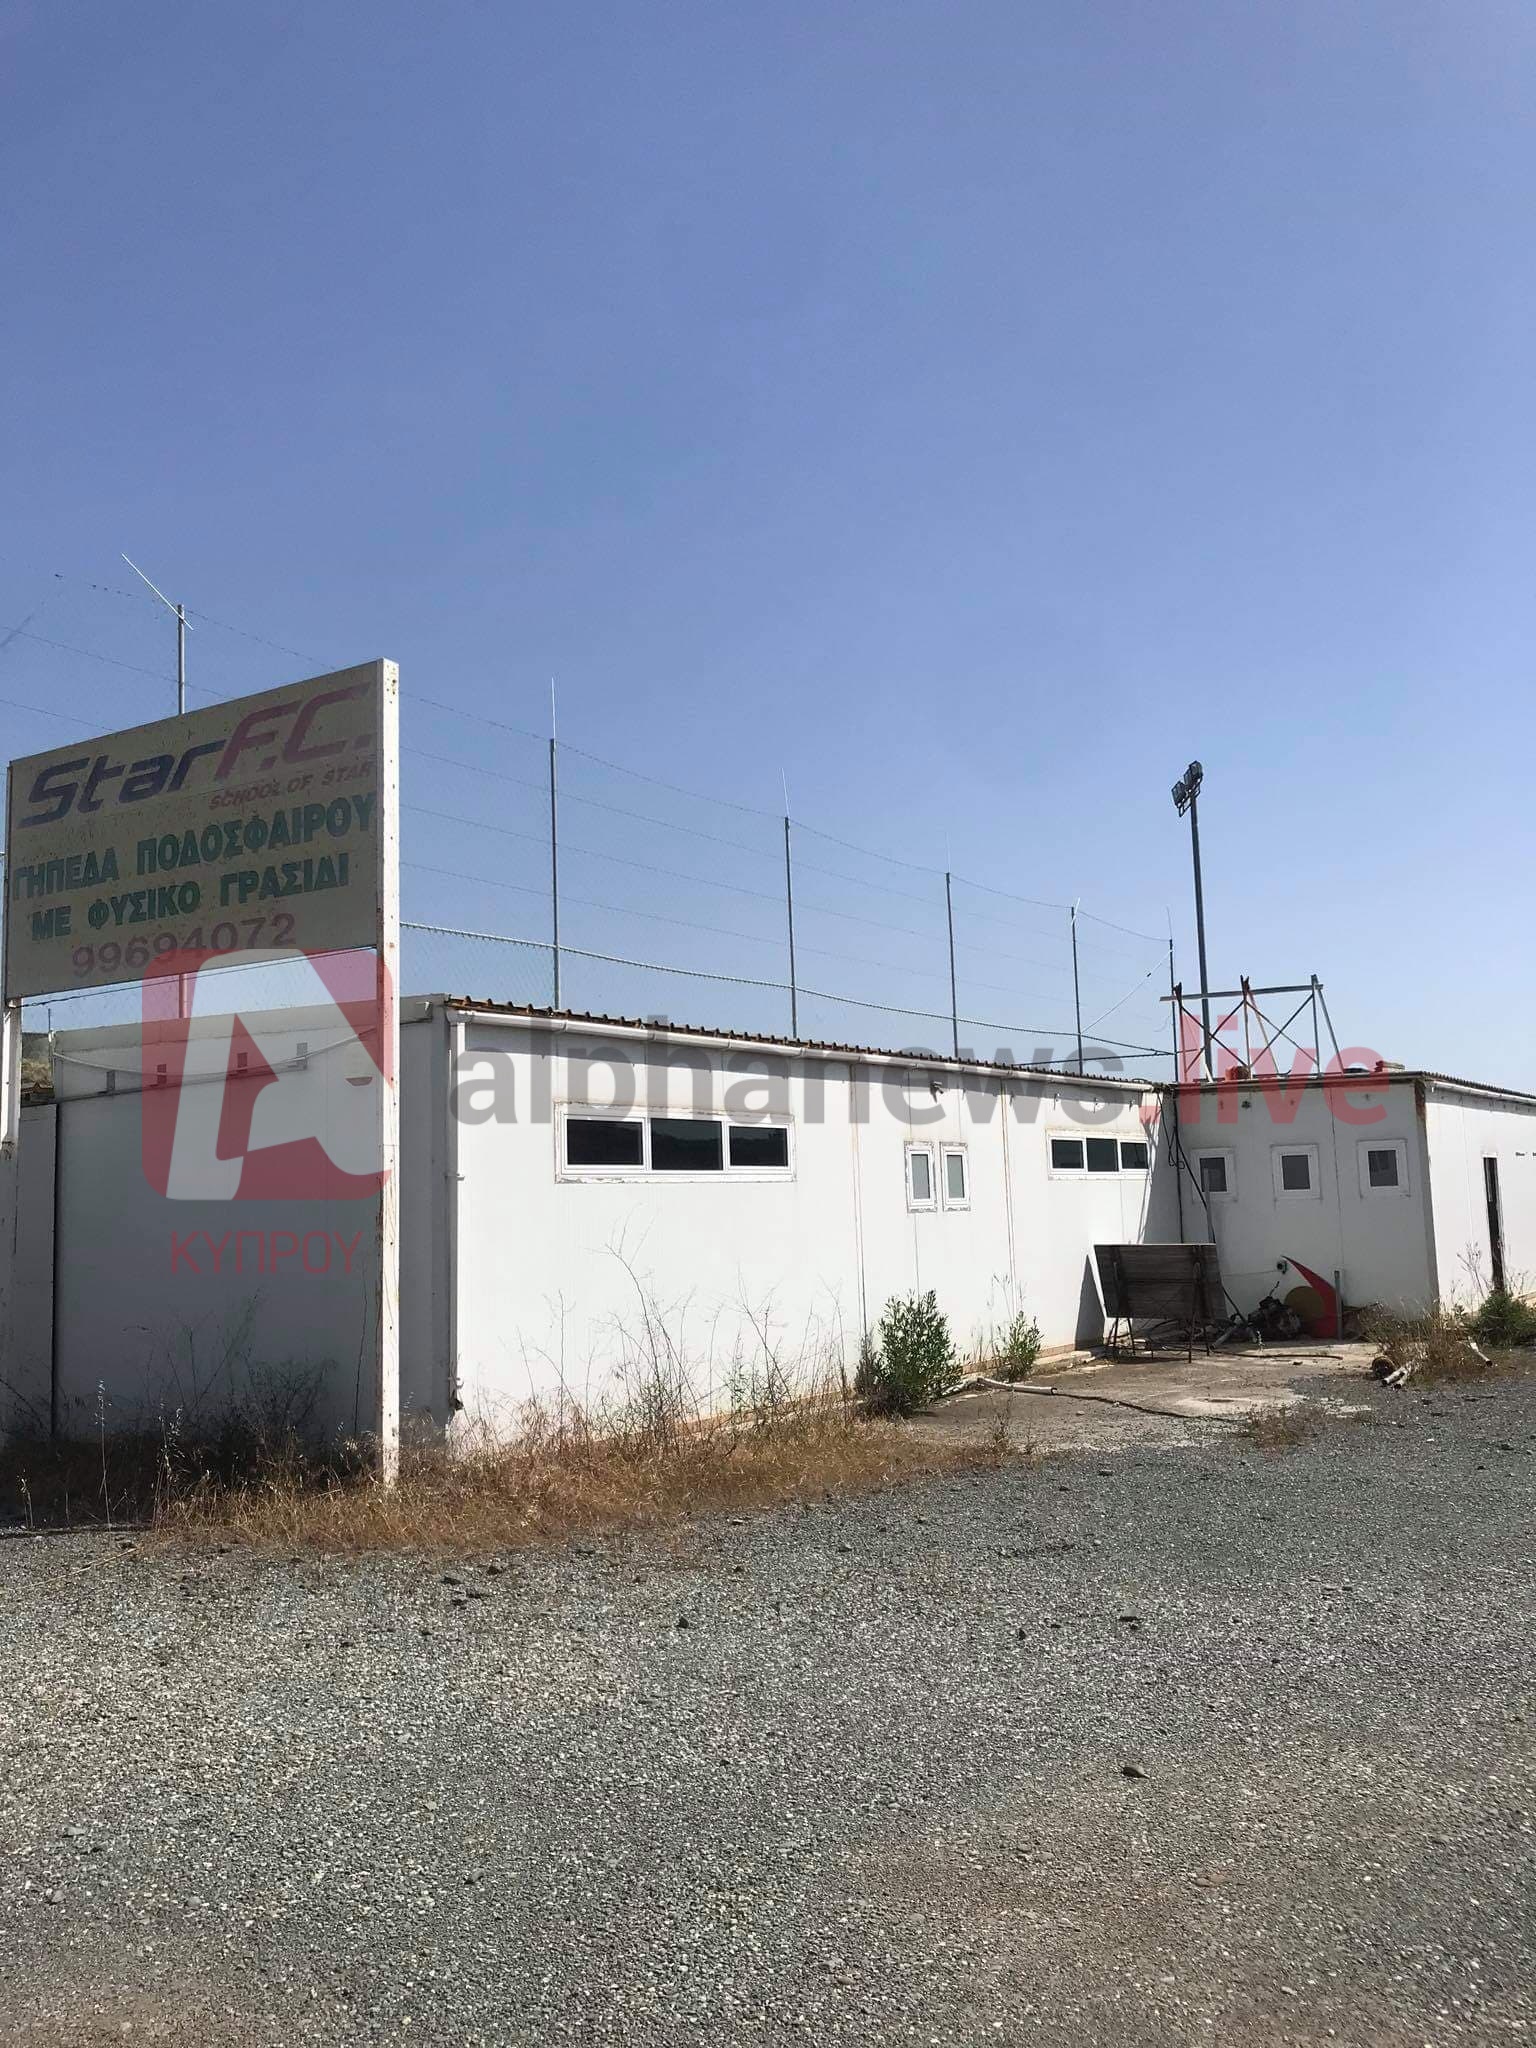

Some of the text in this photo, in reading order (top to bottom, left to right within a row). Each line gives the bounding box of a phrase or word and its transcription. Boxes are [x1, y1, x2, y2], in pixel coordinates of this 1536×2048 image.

[208, 779, 281, 811] SCHOOL
[287, 774, 312, 794] OF
[14, 793, 377, 899] ΓΗΠΕΔΑ ΠΟΔΟΣΦΑΙΡΟΥ
[32, 853, 349, 941] ΜΕ ΦΥΣΙΚΟ ΓΡΑΣΙΔΙ
[72, 912, 297, 979] 99694072
